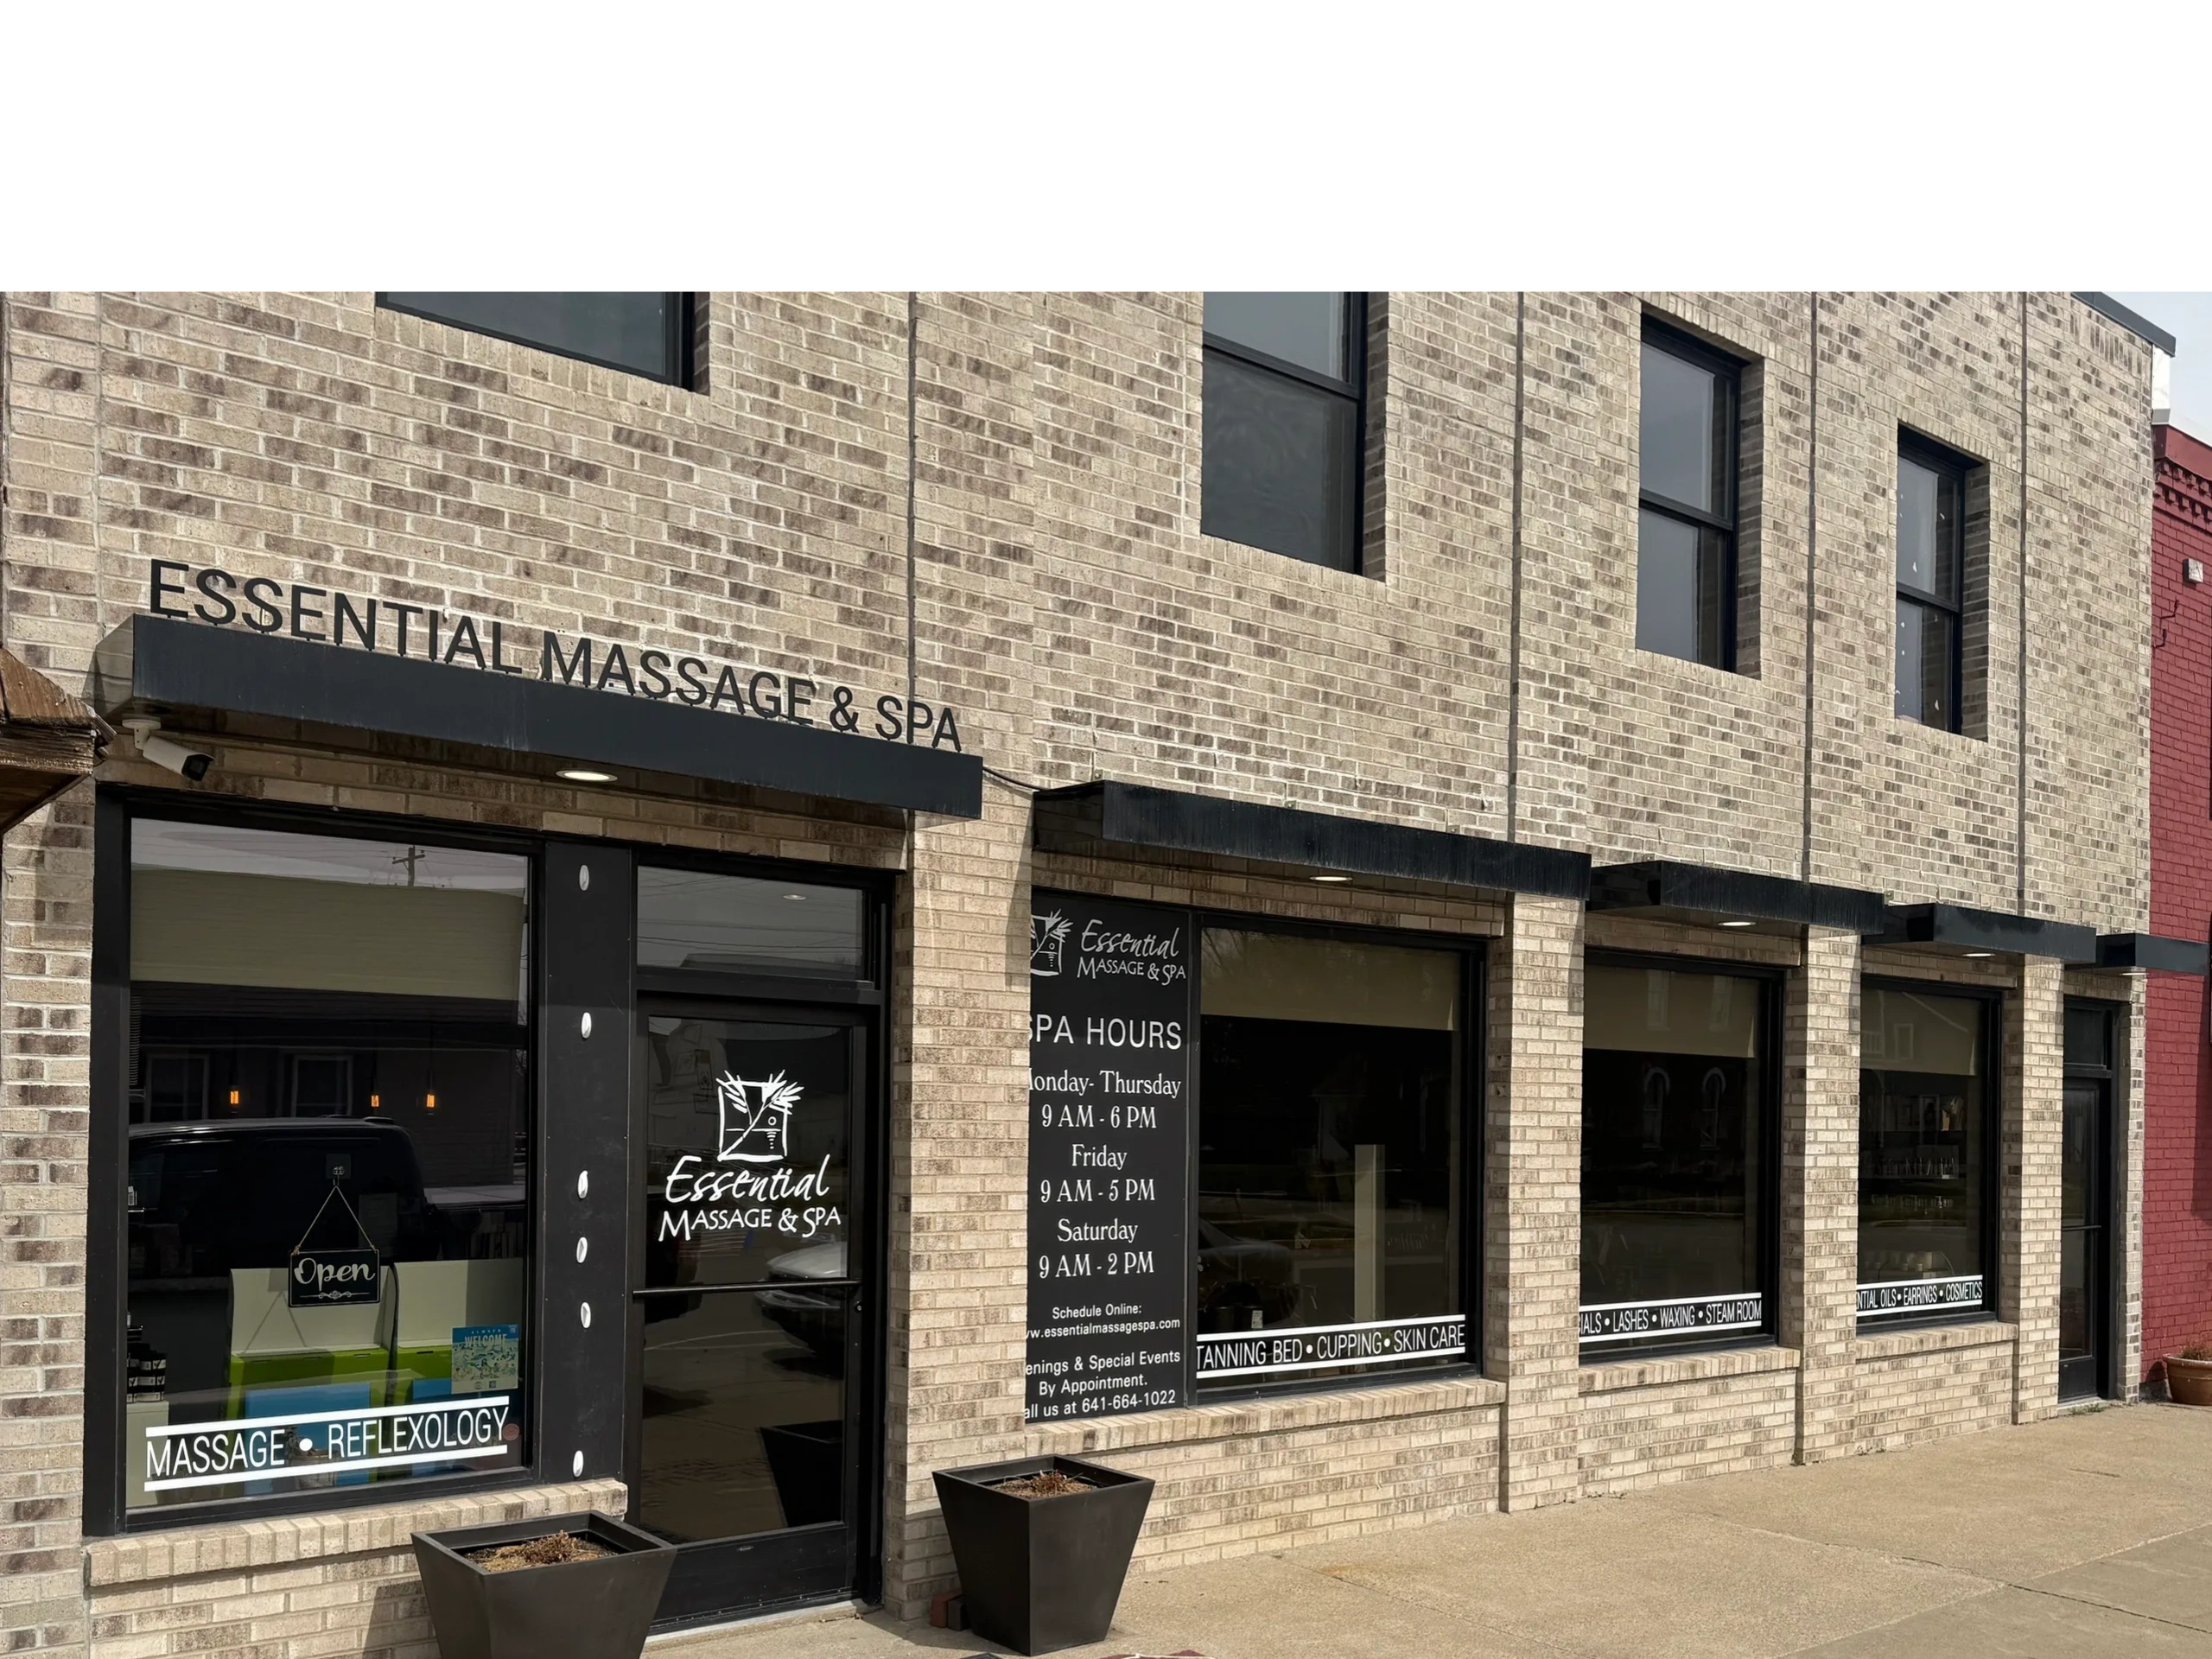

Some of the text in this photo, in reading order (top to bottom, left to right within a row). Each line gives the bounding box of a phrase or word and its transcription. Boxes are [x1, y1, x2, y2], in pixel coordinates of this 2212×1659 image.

[149, 557, 962, 752] ESSENTIAL MASSAGE & SPA
[1080, 918, 1179, 957] Essential
[1077, 957, 1185, 985] MASSAGE & SPA
[1087, 1017, 1181, 1049] HOURS
[1029, 1068, 1181, 1098] onday- Thursday
[1041, 1103, 1052, 1127] 9
[1058, 1104, 1093, 1127] AM
[1110, 1106, 1121, 1128] 6
[1126, 1106, 1156, 1128] PM
[1071, 1143, 1127, 1170] Friday
[664, 1154, 830, 1203] Essential
[1040, 1179, 1051, 1202] 9
[1056, 1179, 1092, 1201] AM
[1109, 1179, 1119, 1200] 5
[1125, 1178, 1155, 1200] PM
[658, 1206, 841, 1242] MASSAGE & SPA
[1057, 1217, 1137, 1243] Saturday
[294, 1257, 375, 1291] Open
[1038, 1255, 1049, 1278] 9
[1055, 1254, 1091, 1277] AM
[1107, 1252, 1117, 1274] 2
[1123, 1251, 1154, 1273] PM
[1856, 1281, 1982, 1310] NTIAL OILS EARRINGS COSMETICS
[1052, 1303, 1141, 1319] Schedule Online:
[1578, 1299, 1761, 1334] IALS LASHES WAXING STEAM ROOM
[464, 1333, 506, 1346] WELCOME
[1026, 1319, 1180, 1338] w.essentialmassagespa.com
[1196, 1323, 1465, 1369] TANNING BED CUPPING SKIN CARE
[1026, 1350, 1180, 1375] enings & Special Events
[1039, 1374, 1147, 1396] By Appointment.
[1025, 1389, 1175, 1418] all us at 641-664-1022
[145, 1406, 510, 1478] MASSAGE REFLEXOLOGY
